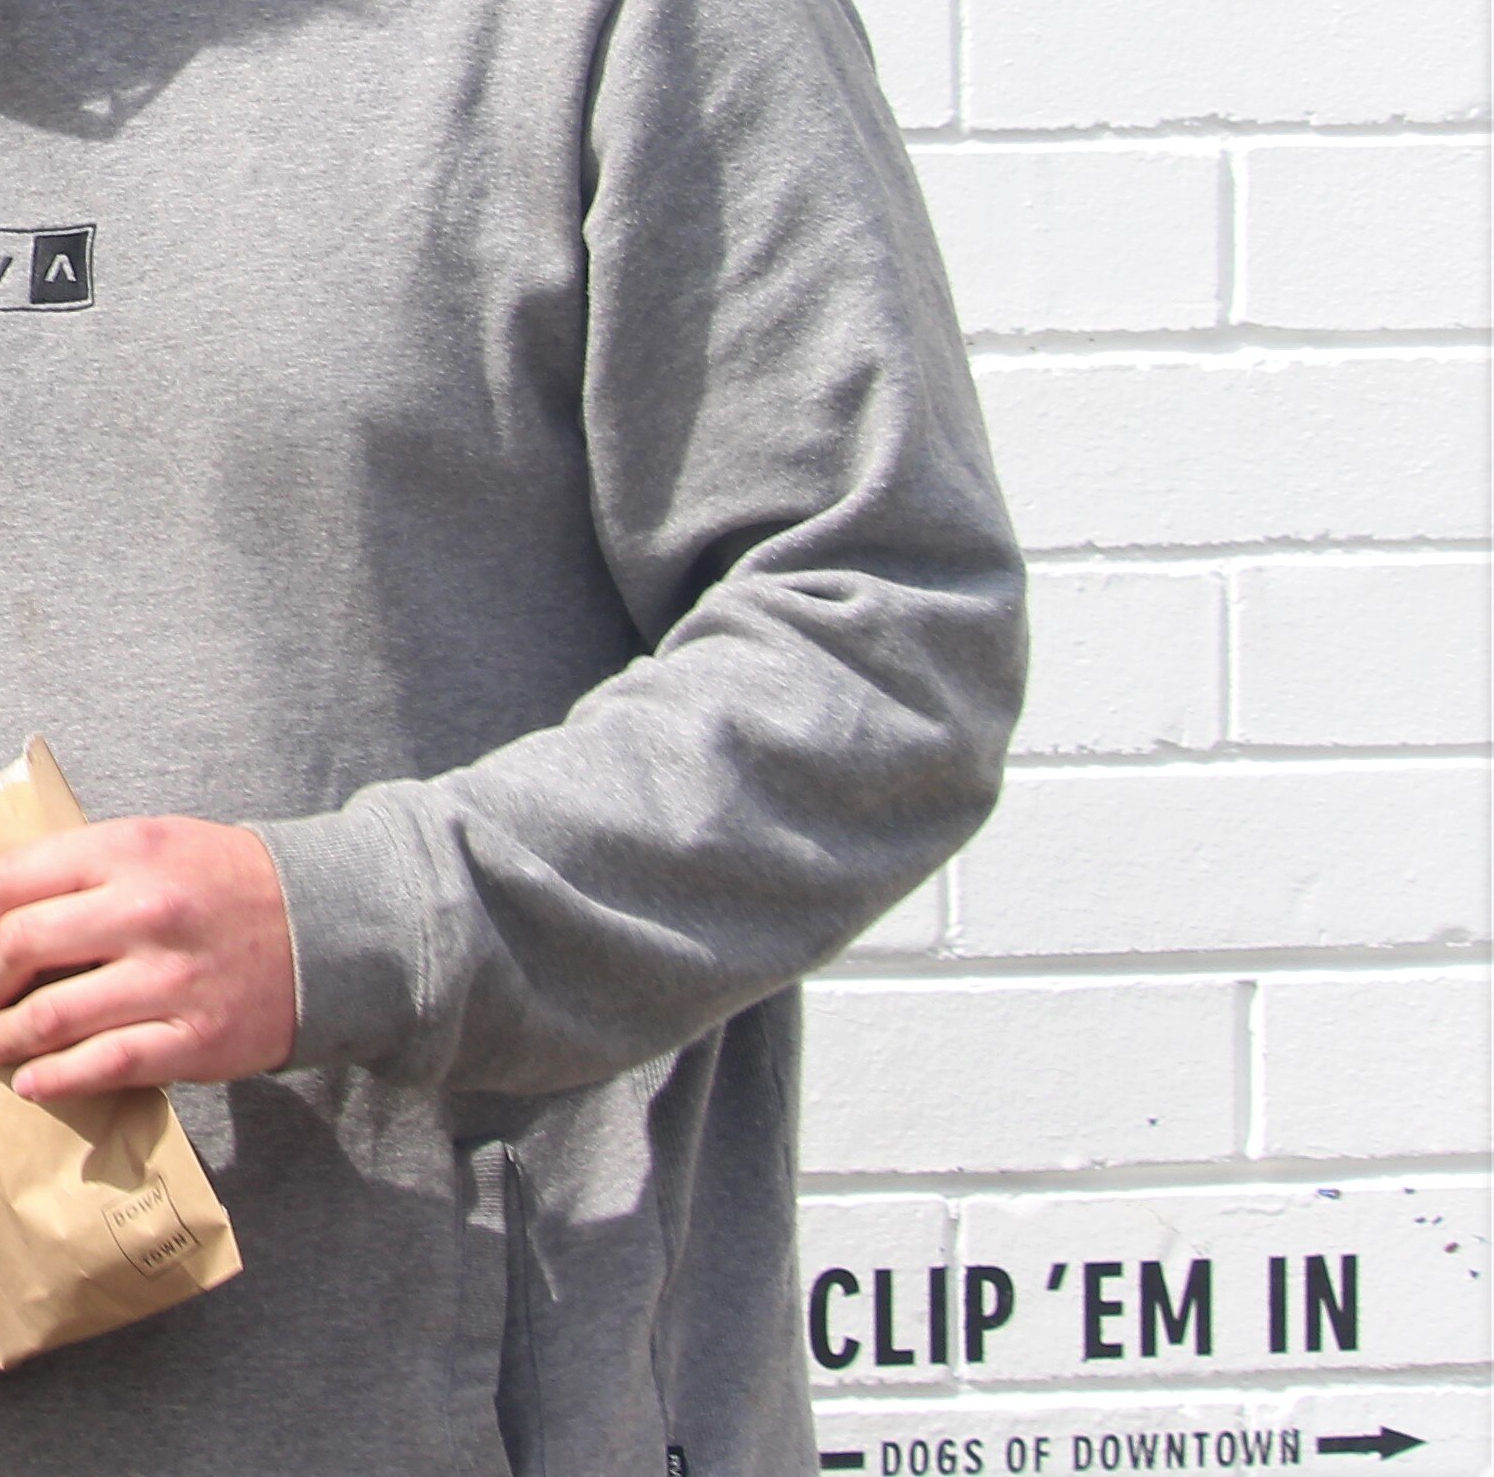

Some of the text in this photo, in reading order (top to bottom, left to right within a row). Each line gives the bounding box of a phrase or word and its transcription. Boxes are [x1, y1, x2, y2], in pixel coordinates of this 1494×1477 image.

[113, 1186, 163, 1228] DOWN
[142, 1232, 188, 1269] TOWN
[809, 1253, 1360, 1370] CLIP 'EM IN
[880, 1427, 1302, 1477] DOGS OF DOWNTOWN
